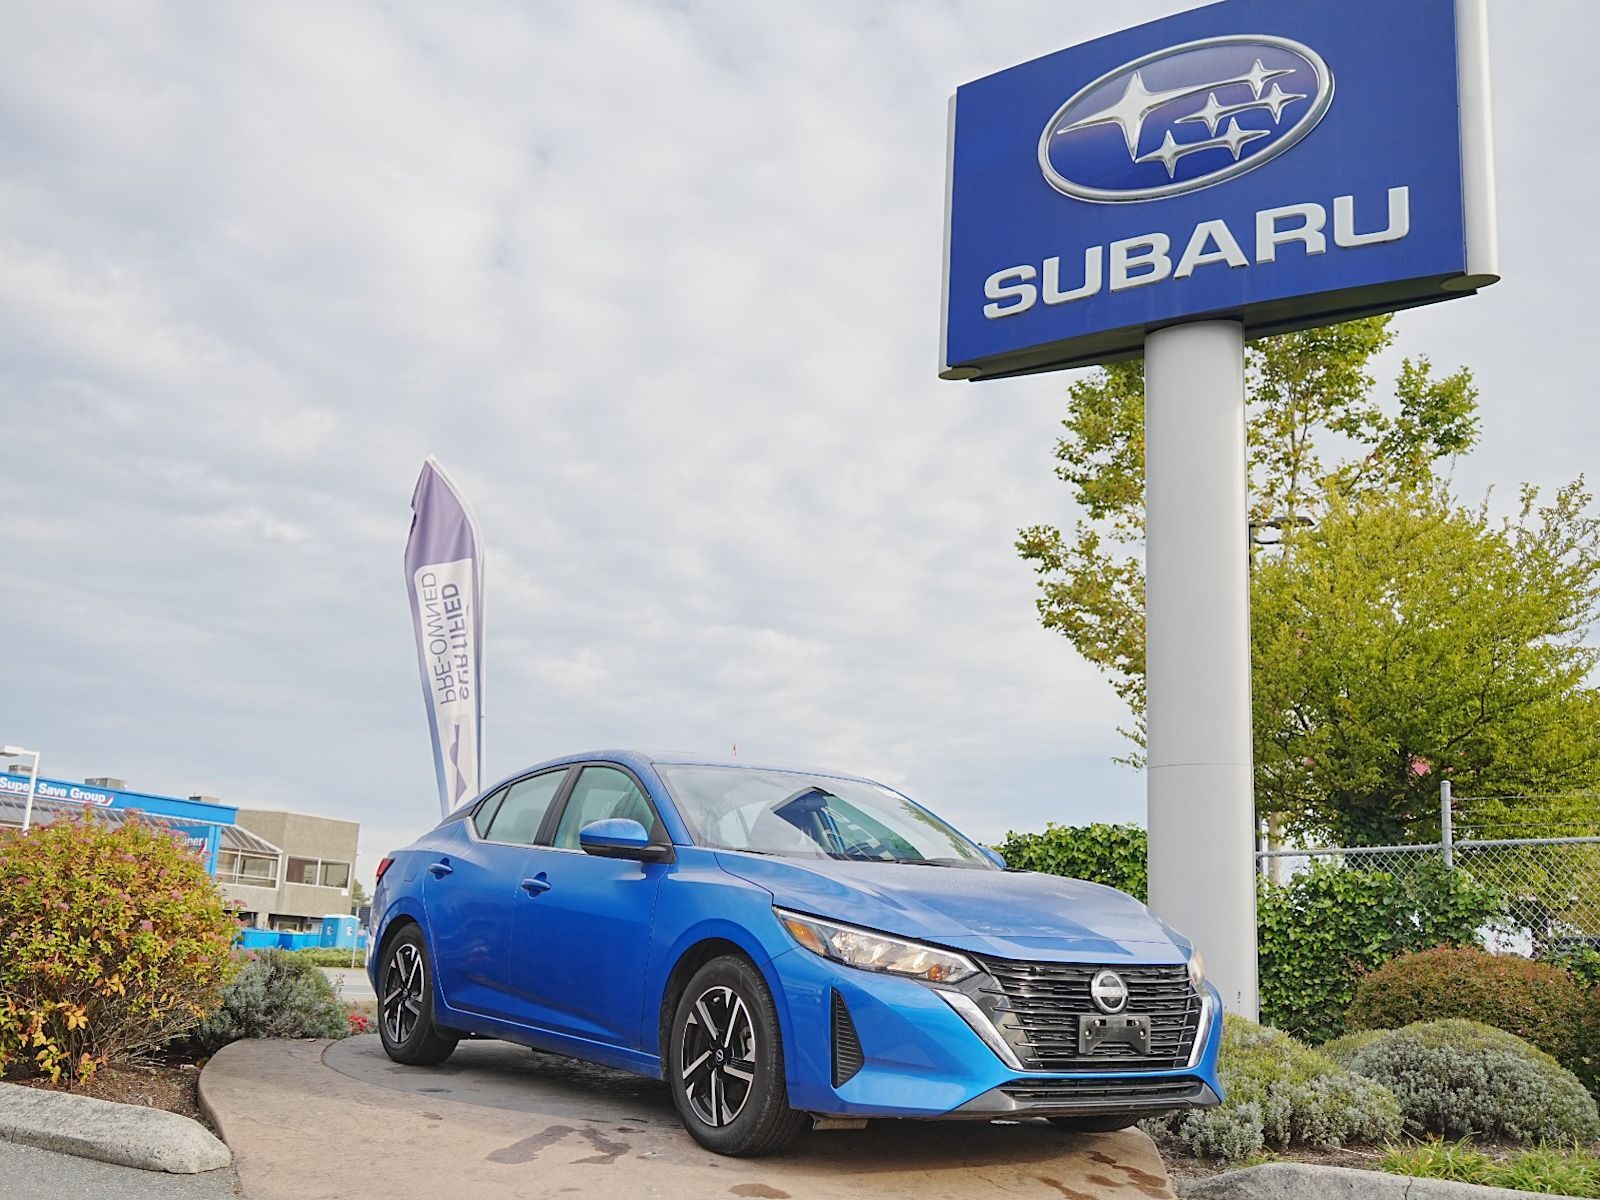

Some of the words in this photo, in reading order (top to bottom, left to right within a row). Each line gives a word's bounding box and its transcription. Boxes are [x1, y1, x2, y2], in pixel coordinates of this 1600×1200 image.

[983, 186, 1410, 319] SUBARU
[0, 777, 35, 792] Supe
[38, 782, 67, 797] Save
[70, 787, 106, 804] Group
